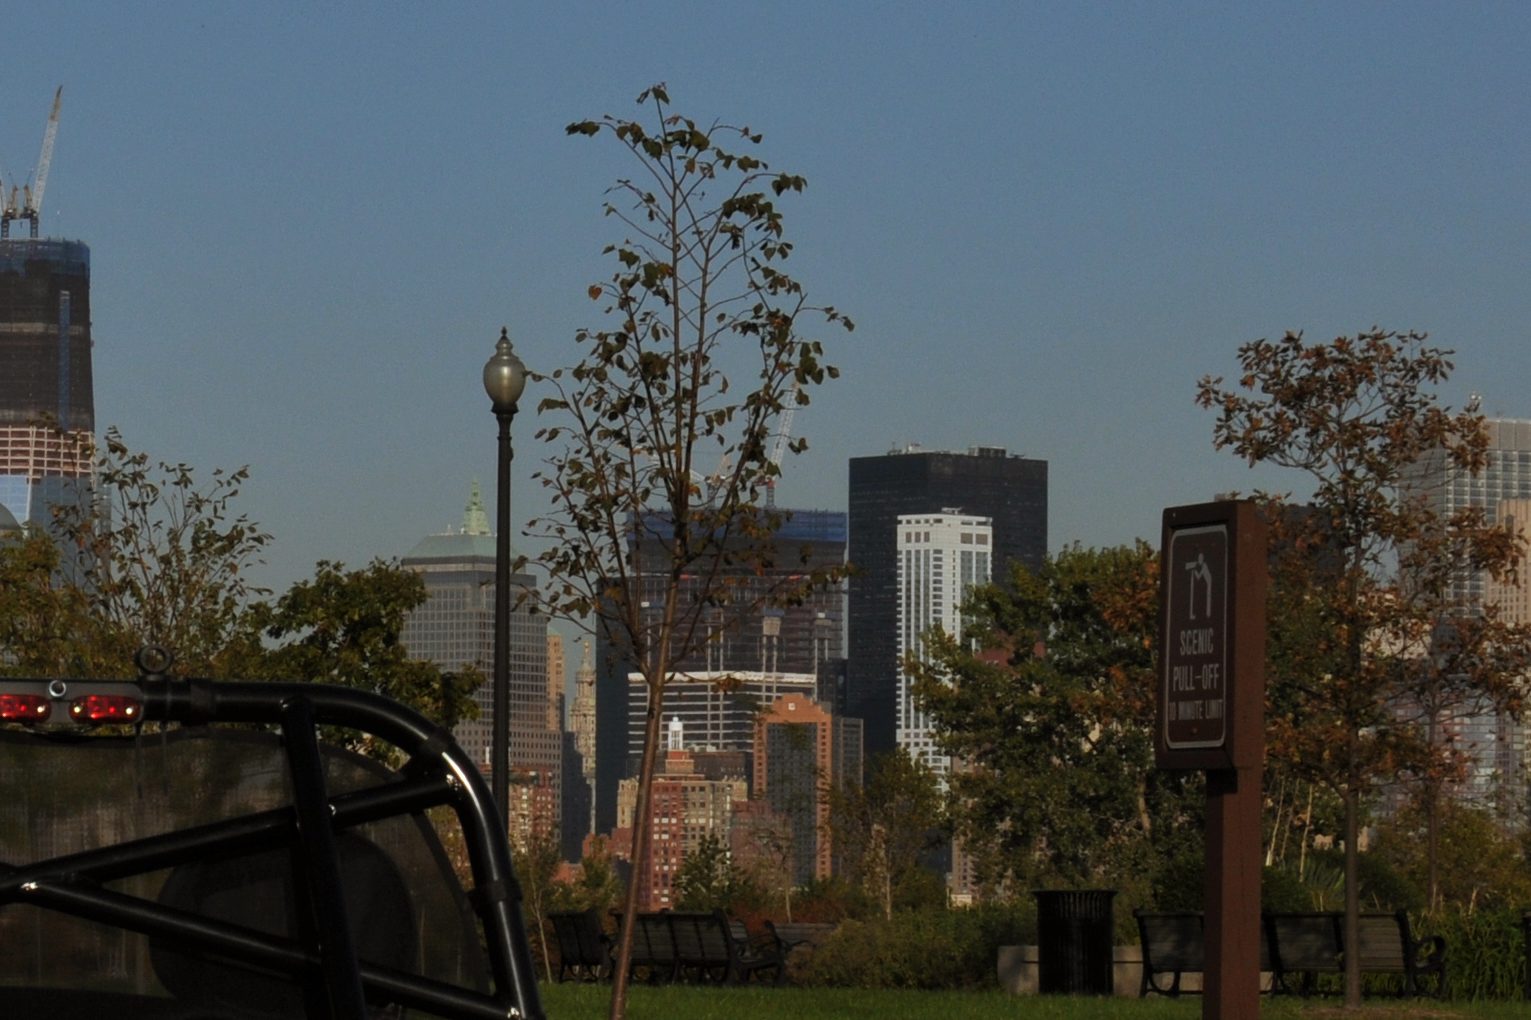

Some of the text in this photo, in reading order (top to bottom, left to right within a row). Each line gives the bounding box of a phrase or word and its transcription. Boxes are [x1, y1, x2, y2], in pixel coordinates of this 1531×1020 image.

[1180, 628, 1214, 656] SCENIC
[1173, 664, 1219, 692] PULL-OFF
[1178, 700, 1203, 720] MINUTE
[1205, 699, 1223, 719] LIMIT
